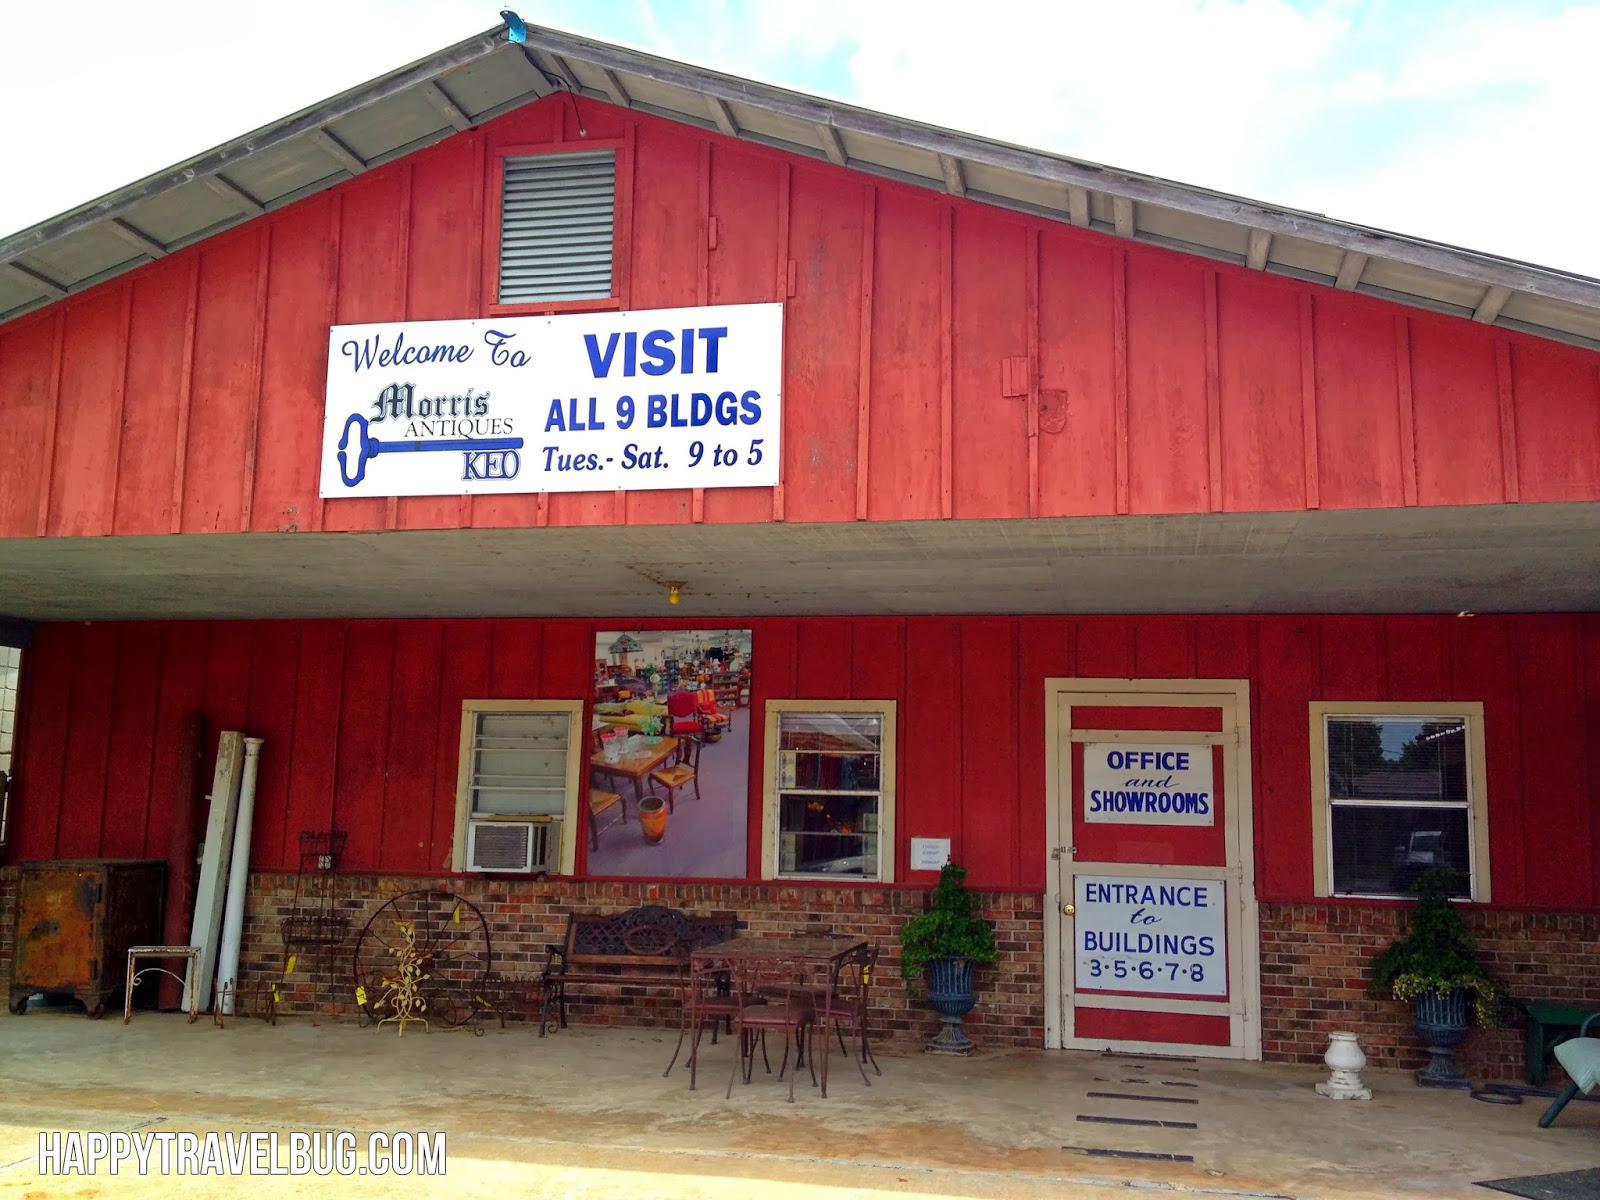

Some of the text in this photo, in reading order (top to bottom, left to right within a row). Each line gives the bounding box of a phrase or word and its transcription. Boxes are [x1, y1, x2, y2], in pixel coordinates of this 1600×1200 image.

[341, 329, 532, 373] Welcome To
[583, 327, 728, 378] VISIT
[369, 382, 491, 423] Morris
[544, 390, 762, 432] ALL 9 BLDGS
[404, 418, 513, 439] ANTIQUES
[461, 448, 521, 481] KEO
[621, 442, 669, 470] Sat.
[687, 440, 705, 468] 9
[714, 443, 738, 467] to
[747, 438, 765, 466] 5
[1107, 751, 1190, 771] OFFICE
[1122, 774, 1180, 789] and
[1090, 790, 1209, 815] SHOWROOMS
[1086, 883, 1208, 908] ENTRANCE
[1130, 908, 1162, 925] to
[1084, 931, 1215, 956] BUILDINGS
